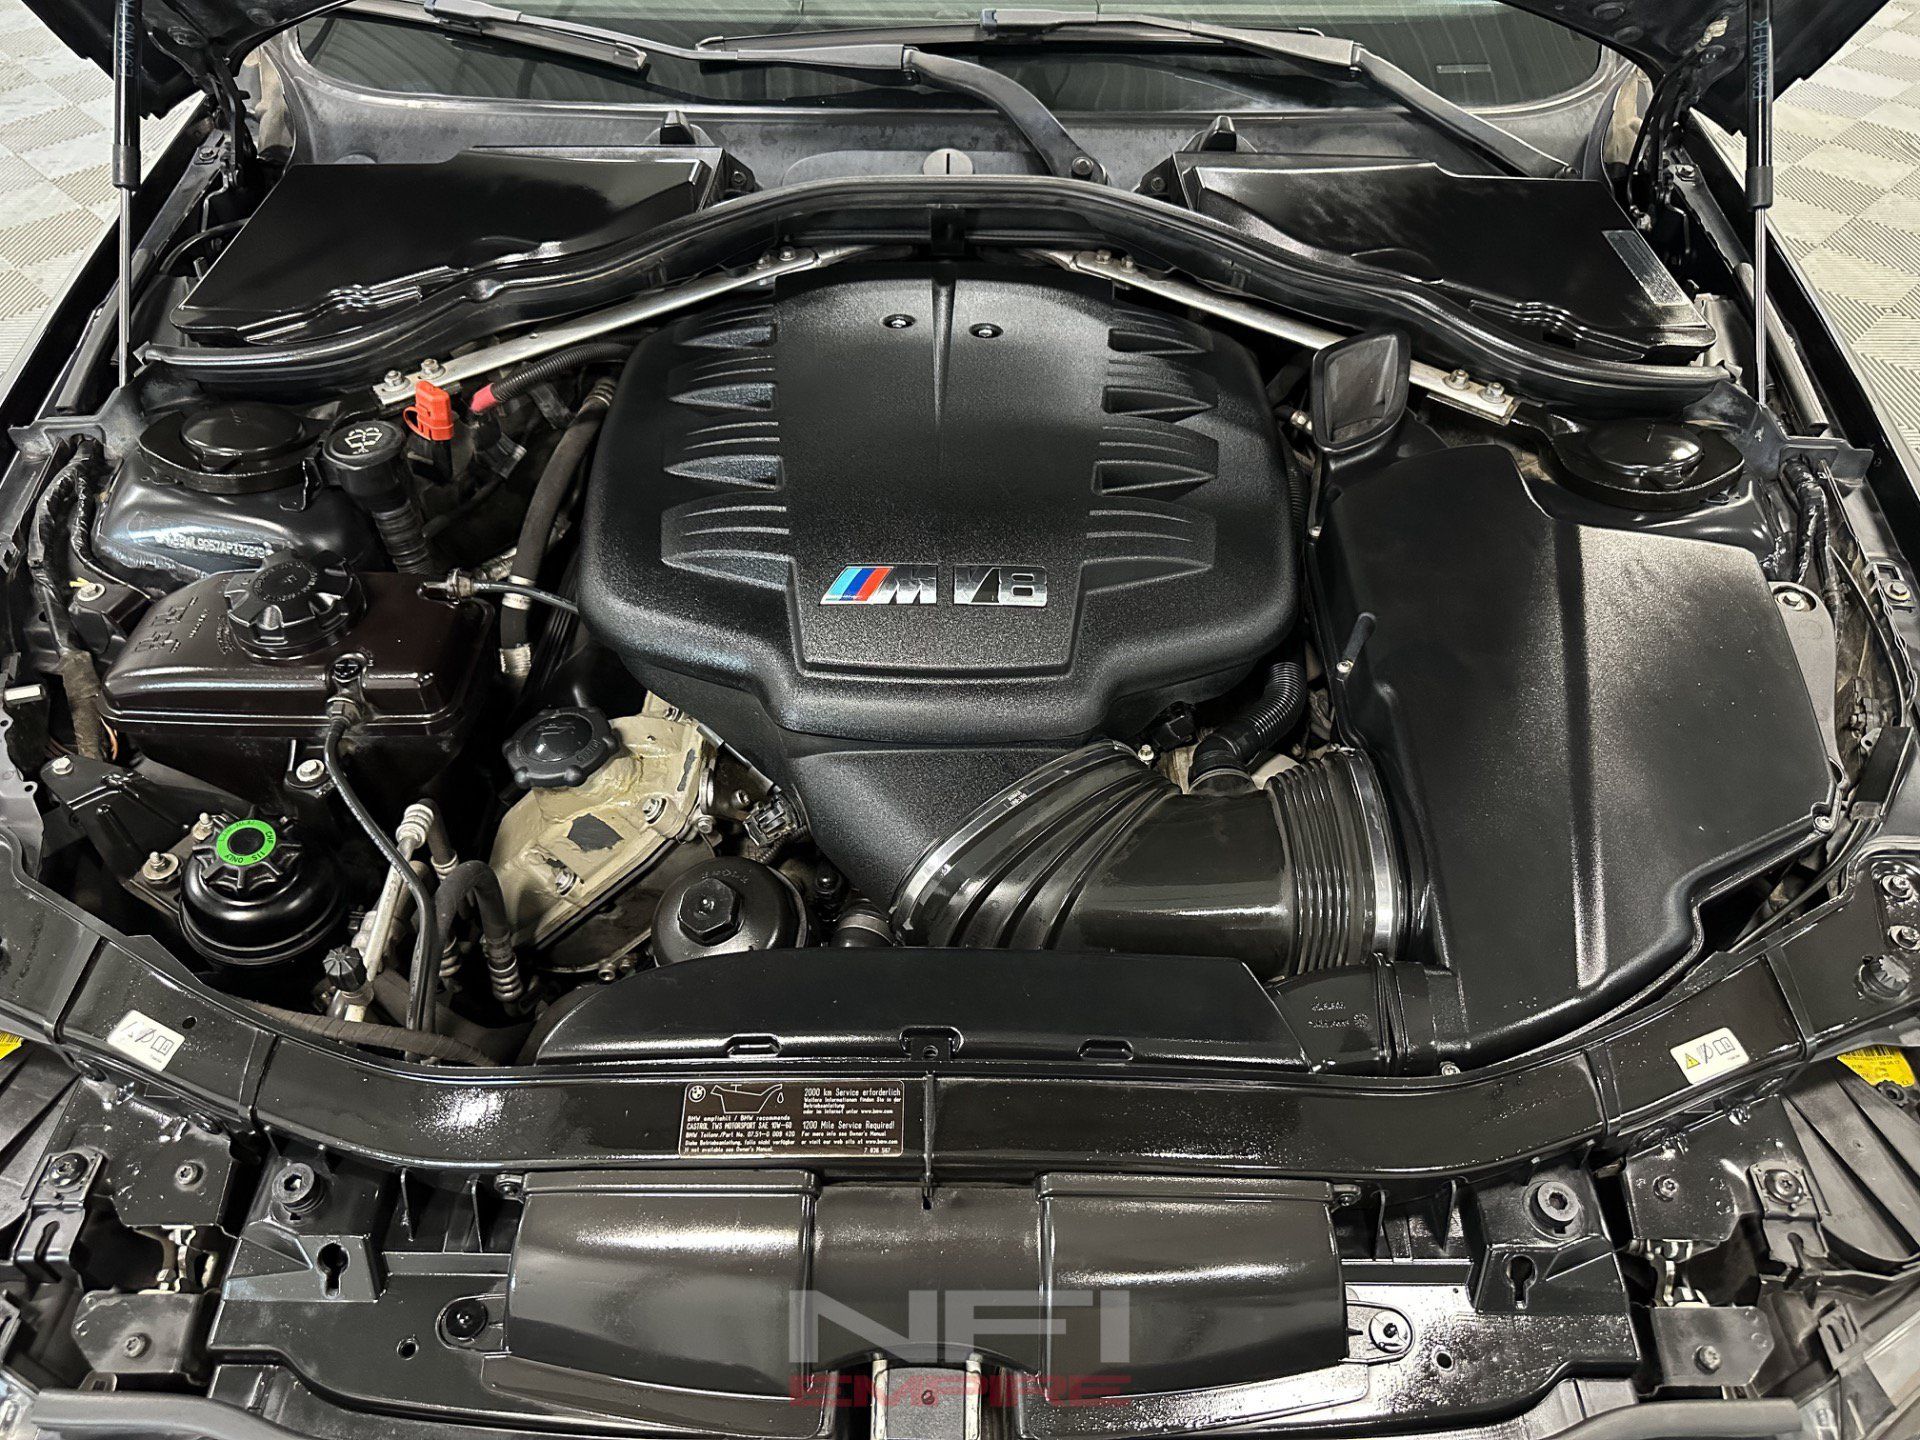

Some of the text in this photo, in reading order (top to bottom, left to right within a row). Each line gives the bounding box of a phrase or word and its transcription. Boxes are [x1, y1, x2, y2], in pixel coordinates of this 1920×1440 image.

[1752, 43, 1769, 65] M3
[862, 563, 1048, 607] M V8
[266, 831, 274, 844] CHF
[224, 854, 244, 863] ONLY
[805, 1088, 900, 1096] 2000 km Service erforderlich
[802, 1121, 894, 1130] 1200 Mile Service Required!
